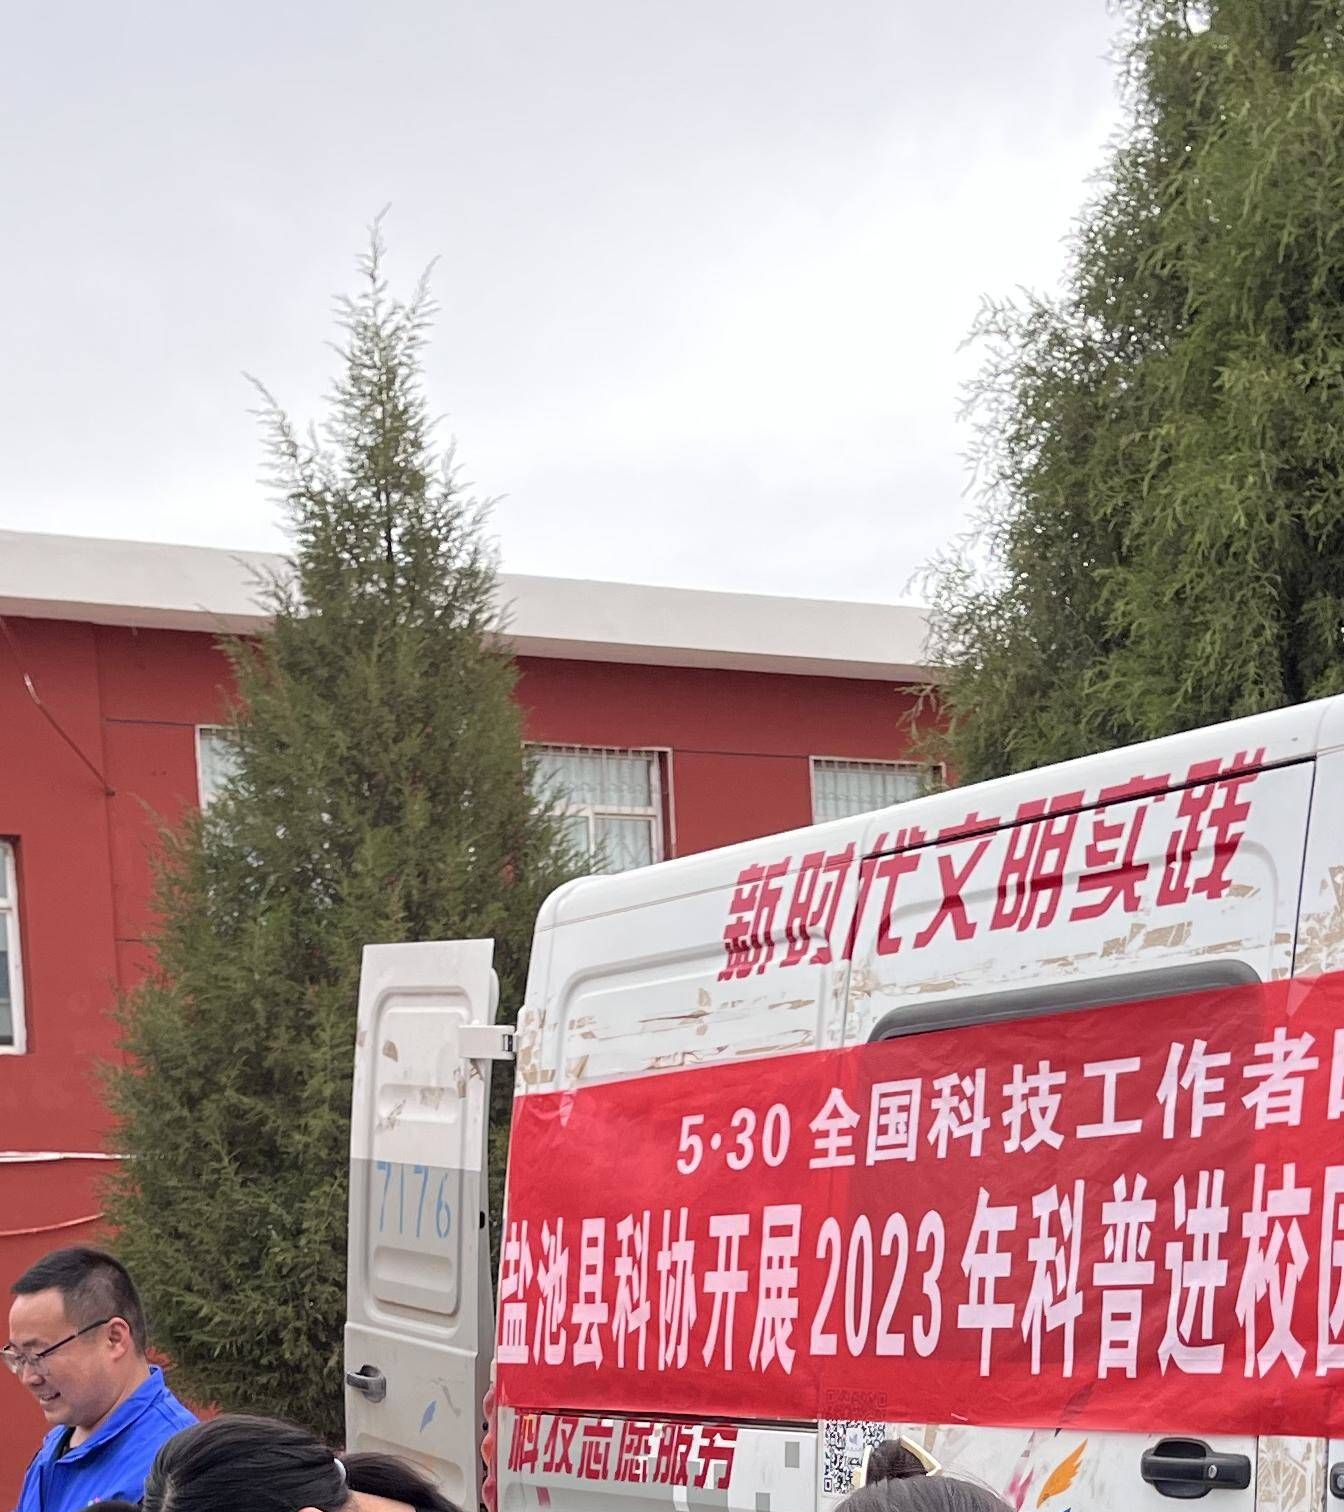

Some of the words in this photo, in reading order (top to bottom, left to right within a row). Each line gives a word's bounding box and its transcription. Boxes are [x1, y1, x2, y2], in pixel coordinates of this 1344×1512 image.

[717, 748, 1266, 982] 新时代文明实践
[376, 1160, 452, 1239] 7176
